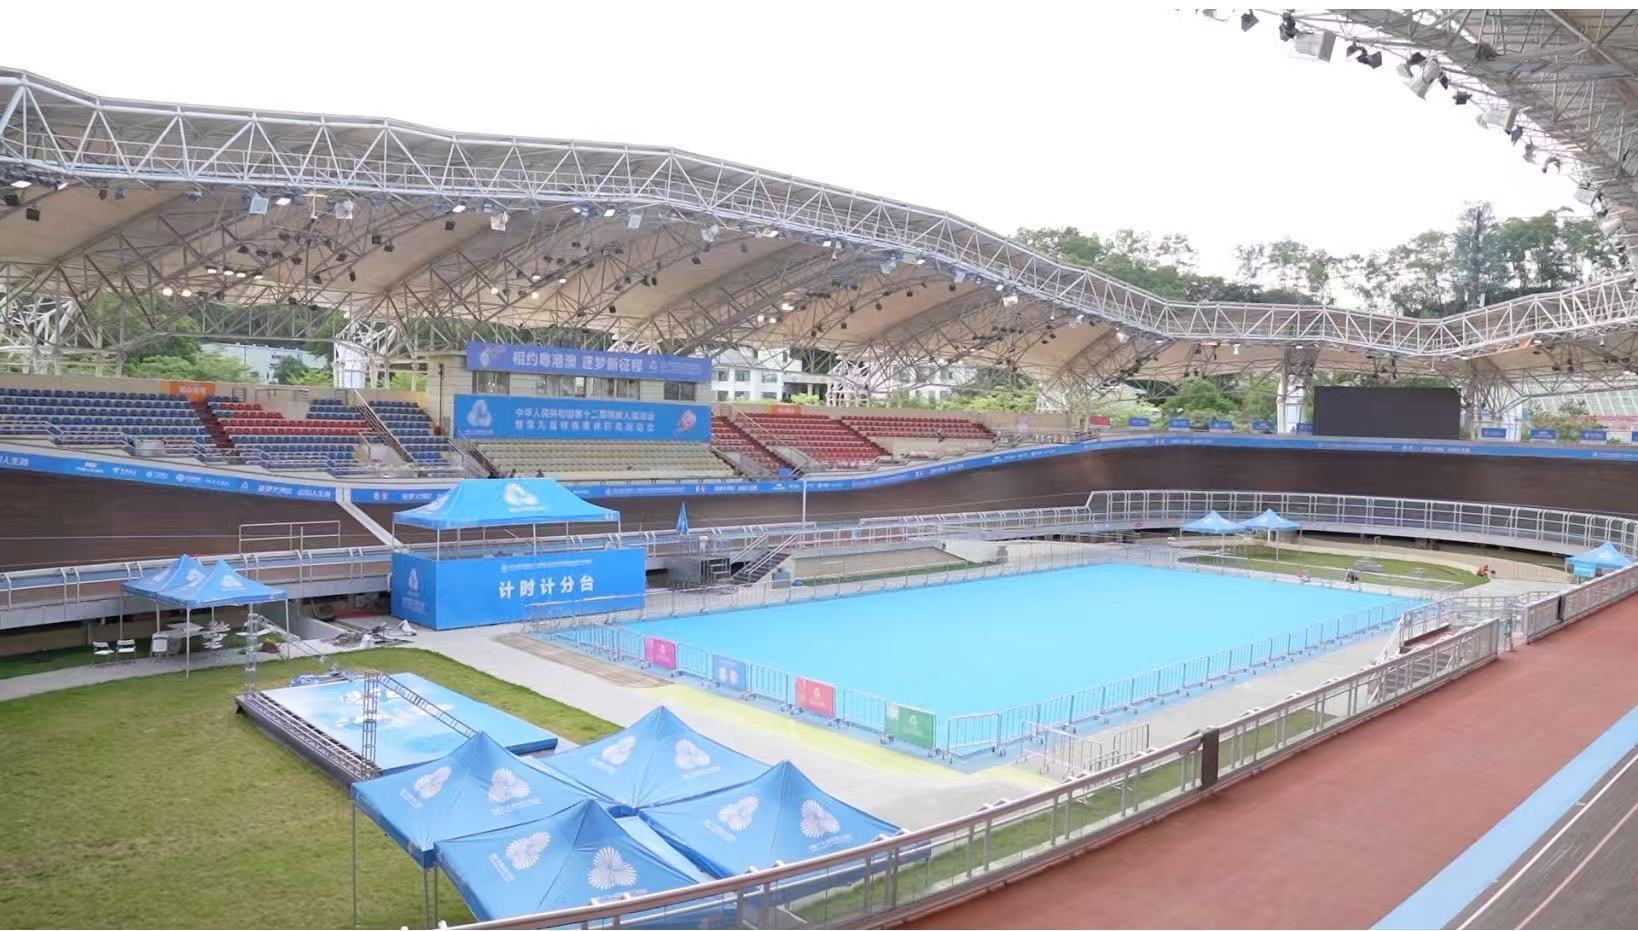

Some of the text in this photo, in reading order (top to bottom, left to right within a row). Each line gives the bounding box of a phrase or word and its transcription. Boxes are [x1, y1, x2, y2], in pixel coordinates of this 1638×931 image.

[512, 350, 577, 370] 相约粤港澳
[498, 575, 594, 599] 计时计分台
